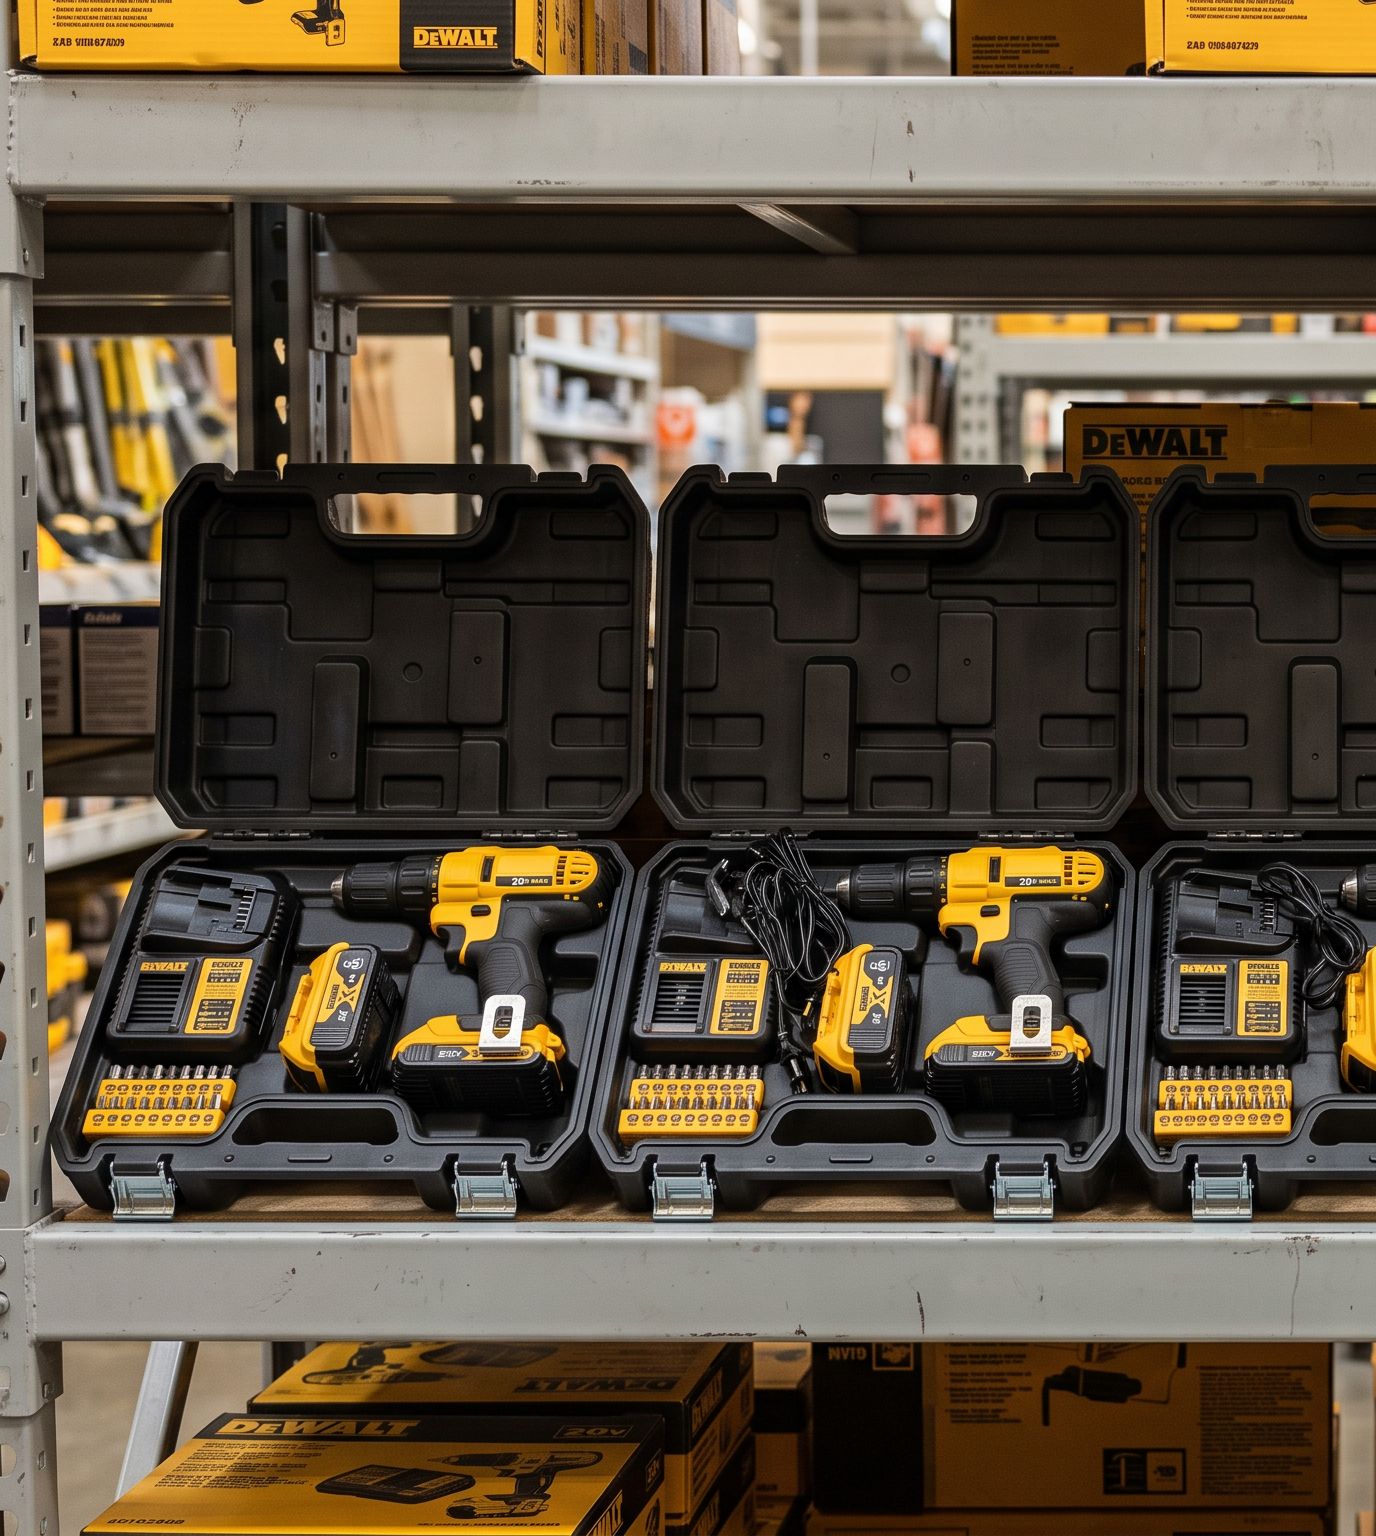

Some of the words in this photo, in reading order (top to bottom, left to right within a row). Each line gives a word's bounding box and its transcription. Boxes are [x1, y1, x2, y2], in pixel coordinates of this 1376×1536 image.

[413, 28, 498, 47] DEWALT
[1082, 428, 1228, 457] DEWALT
[215, 1420, 419, 1435] DEWALT
